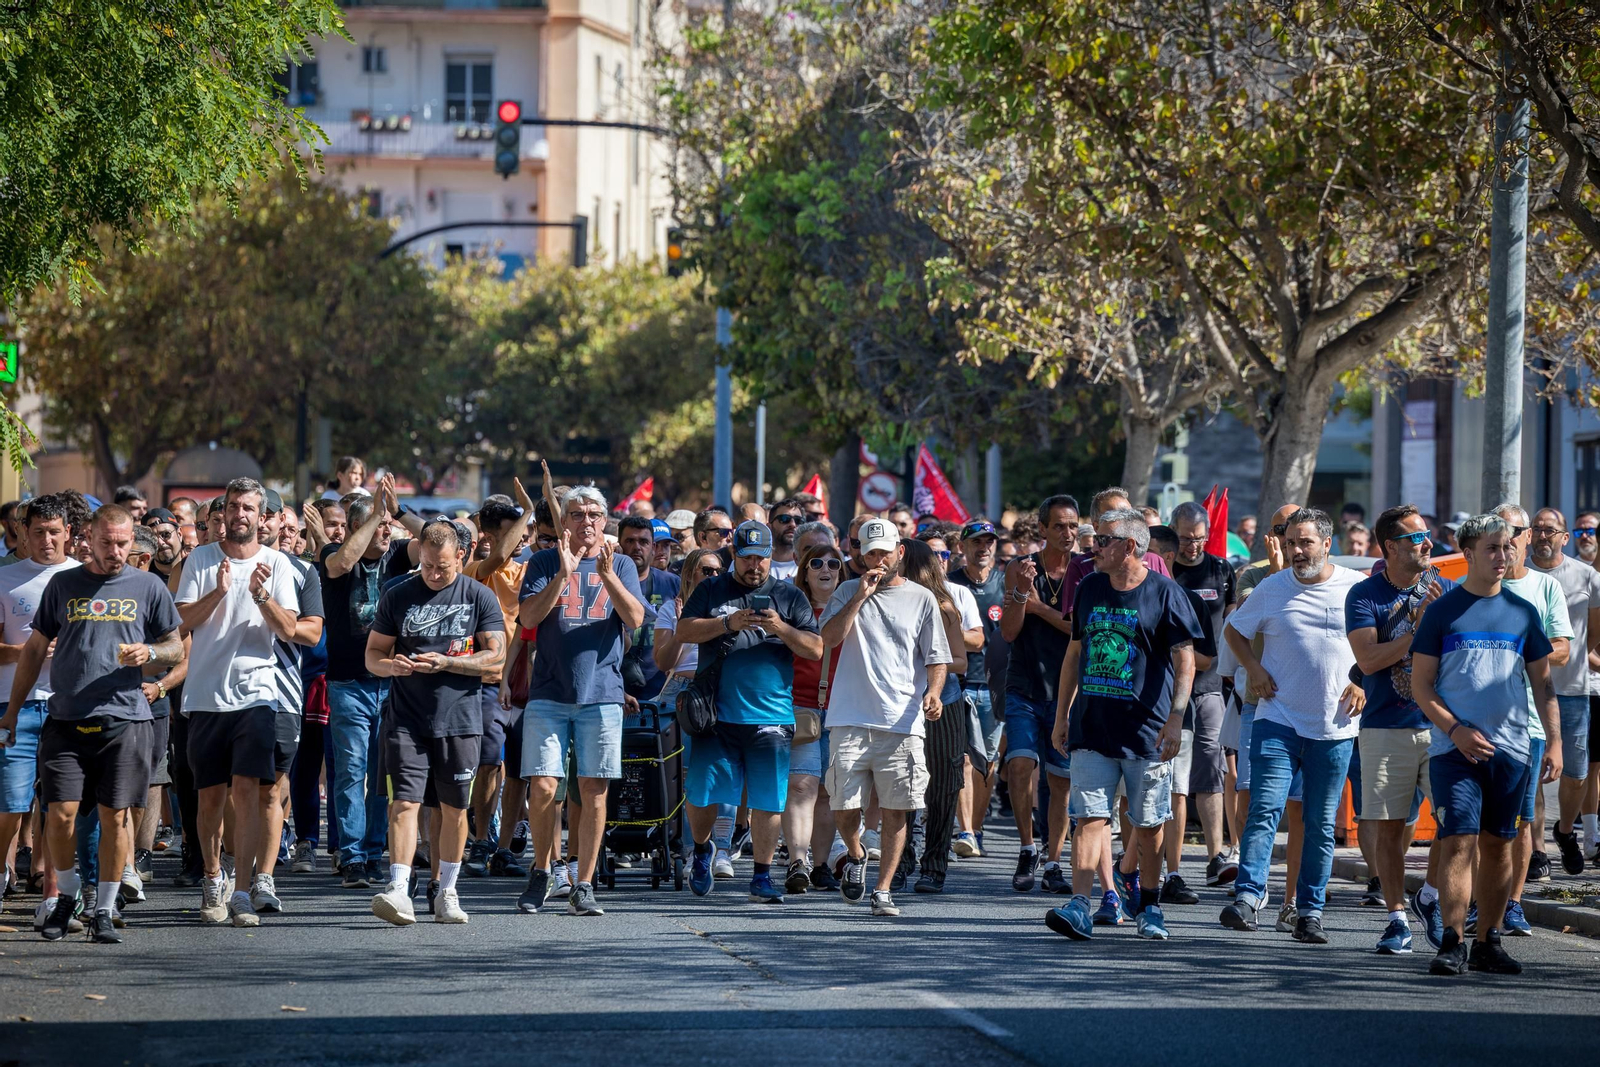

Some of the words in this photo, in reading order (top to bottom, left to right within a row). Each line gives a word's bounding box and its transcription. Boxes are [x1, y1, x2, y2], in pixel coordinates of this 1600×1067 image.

[555, 571, 611, 620] 47
[401, 604, 475, 637] NIKE
[1082, 675, 1133, 690] WITHDRAWALS
[1090, 664, 1124, 677] HAWAII
